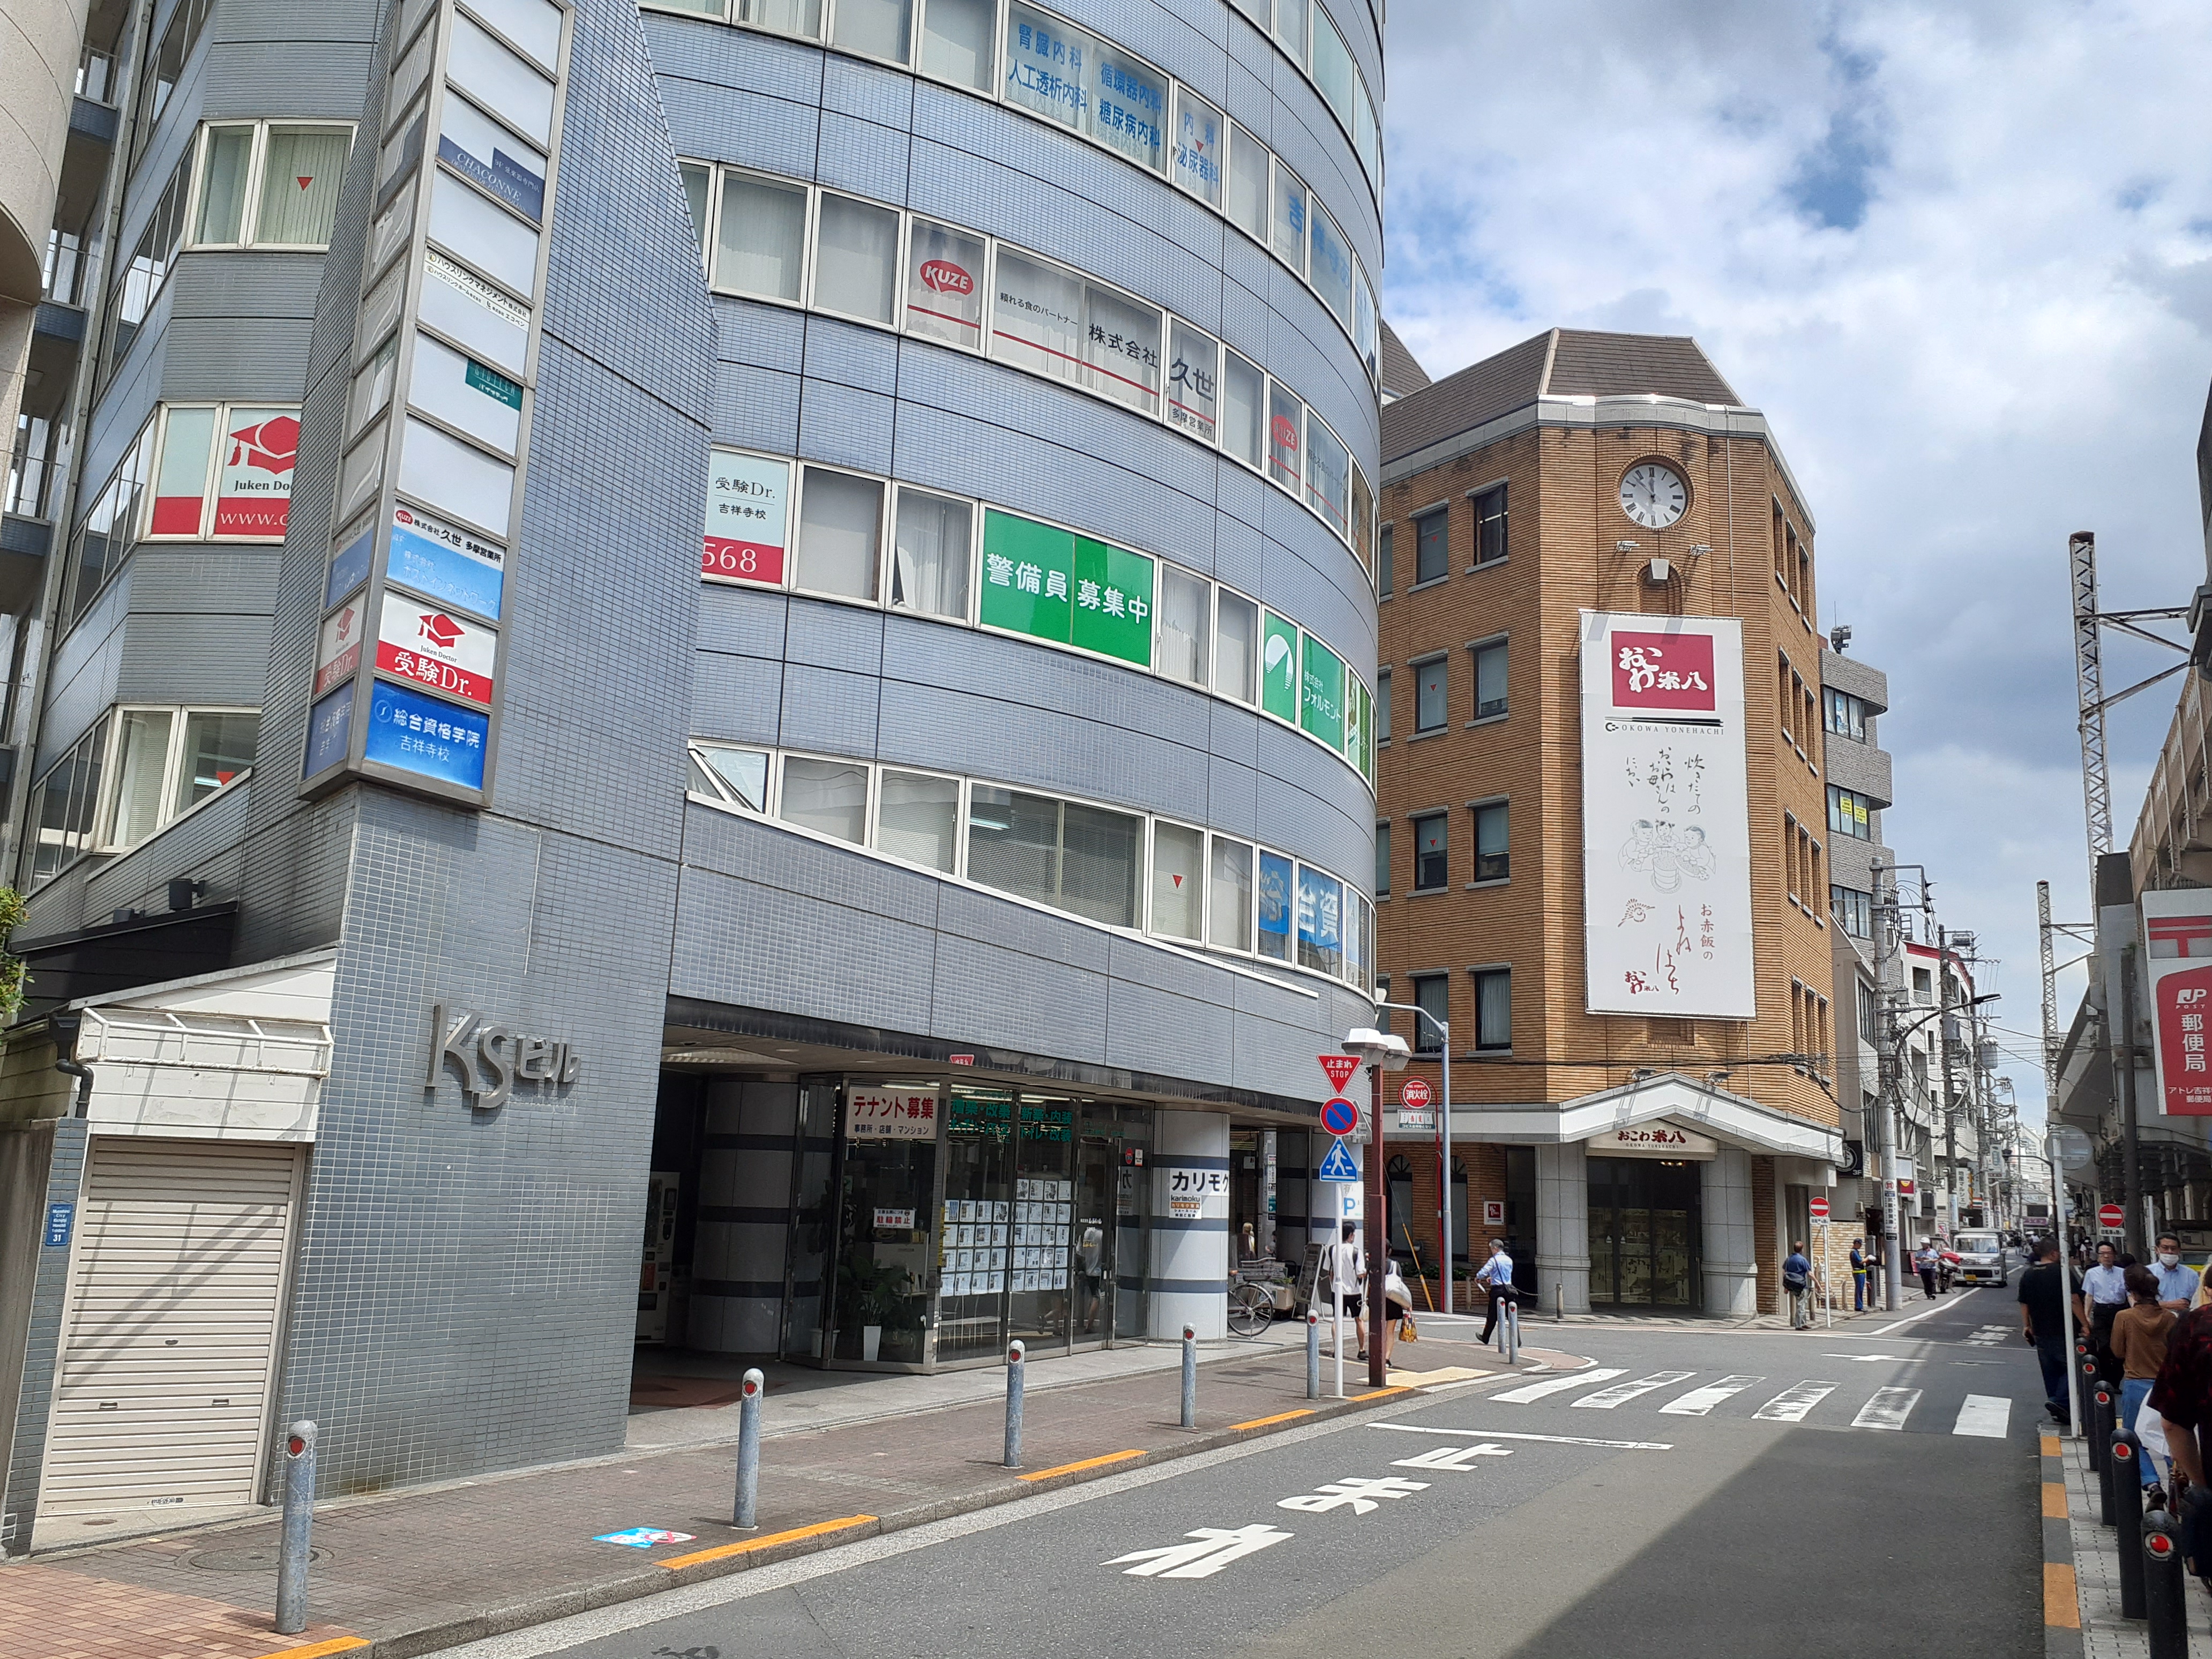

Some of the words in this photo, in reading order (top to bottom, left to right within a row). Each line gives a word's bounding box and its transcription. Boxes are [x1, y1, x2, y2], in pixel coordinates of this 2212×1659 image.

[1019, 23, 1082, 74] 腎臓内科
[1101, 62, 1162, 116] 循環器内科
[1008, 59, 1088, 114] 人工透析内科
[1099, 98, 1161, 153] 糖尿病内科
[1177, 141, 1219, 188] 泌尿器科
[457, 153, 522, 201] CHACONNE
[925, 265, 969, 293] KUZE
[1000, 292, 1078, 325] 頼れる食のパートナー
[1088, 323, 1159, 369] 株式会社
[1170, 357, 1214, 402] 久世
[1172, 408, 1212, 436] 多摩営業所
[234, 480, 270, 492] Juken
[273, 481, 292, 491] Do
[715, 477, 775, 499] 受験Dr.
[397, 511, 412, 524] KUZE
[719, 503, 766, 520] 吉祥寺校
[414, 519, 440, 536] 株式会社
[440, 529, 462, 547] 久世
[465, 541, 502, 564] 多摩営業所
[701, 542, 757, 573] 568
[987, 553, 1068, 603] 警備員
[1077, 579, 1149, 624] 募集中
[420, 645, 437, 656] Juken
[438, 651, 458, 663] Doctor
[394, 652, 472, 696] 受験Dr.
[1304, 670, 1324, 693] 株式会社
[1303, 686, 1341, 723] フォルモント
[393, 708, 481, 749] 総合資格学院
[1621, 724, 1658, 733] OKOWA
[1665, 726, 1724, 735] YONEHACHI
[400, 735, 451, 763] 吉祥寺校
[1700, 903, 1715, 960] お赤飯の
[2181, 1013, 2207, 1072] 郵便局
[1326, 1059, 1353, 1069] 止まれ
[1406, 1089, 1429, 1100] 消火栓
[2168, 1086, 2212, 1095] アトレ吉祥
[854, 1096, 934, 1119] テナント募集
[1172, 1171, 1229, 1193] カリモク
[1343, 1197, 1356, 1216] P
[53, 1234, 62, 1242] 31
